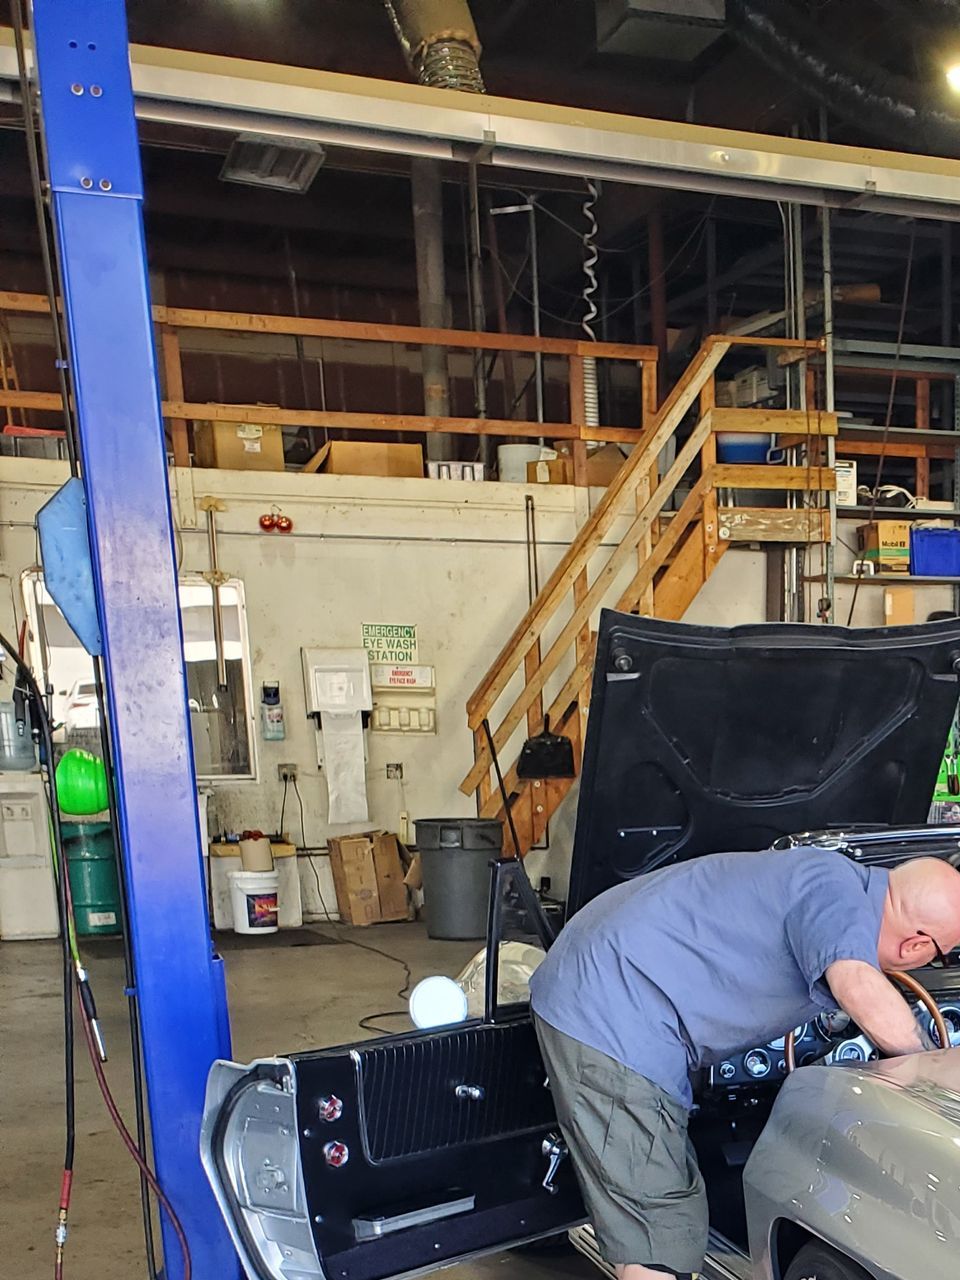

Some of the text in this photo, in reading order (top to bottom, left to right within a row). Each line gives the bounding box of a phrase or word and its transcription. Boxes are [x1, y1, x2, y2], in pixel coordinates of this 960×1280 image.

[363, 625, 415, 638] EMERGENCY
[363, 638, 416, 650] EYE WASH
[368, 650, 412, 662] STATION
